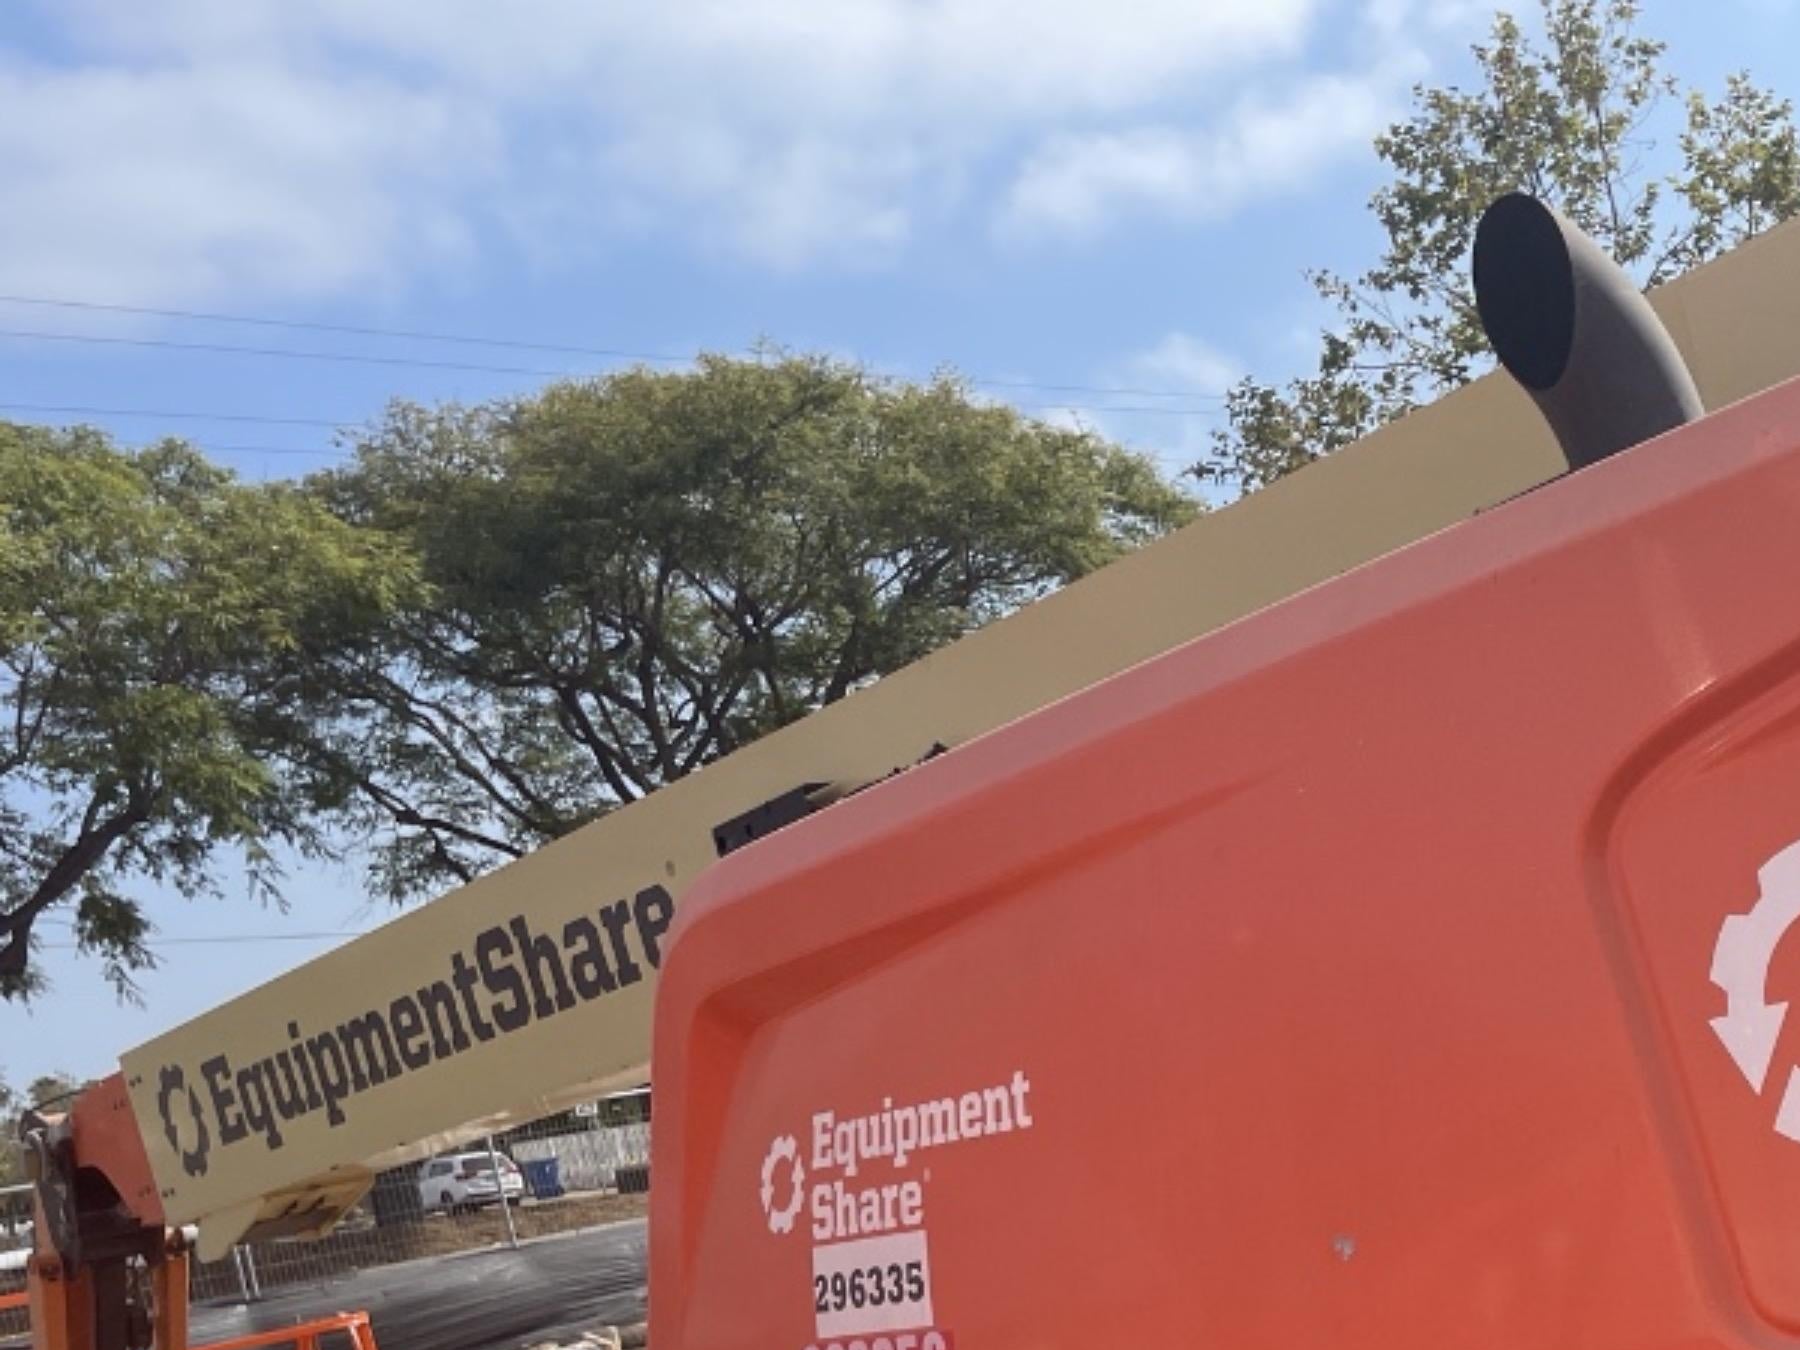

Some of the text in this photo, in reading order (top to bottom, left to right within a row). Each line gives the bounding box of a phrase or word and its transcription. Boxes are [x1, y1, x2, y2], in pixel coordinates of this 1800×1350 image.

[201, 883, 675, 1150] EquipmentShare
[811, 1070, 1033, 1176] Equipment
[811, 1179, 924, 1240] Share
[814, 1260, 926, 1313] 296335
